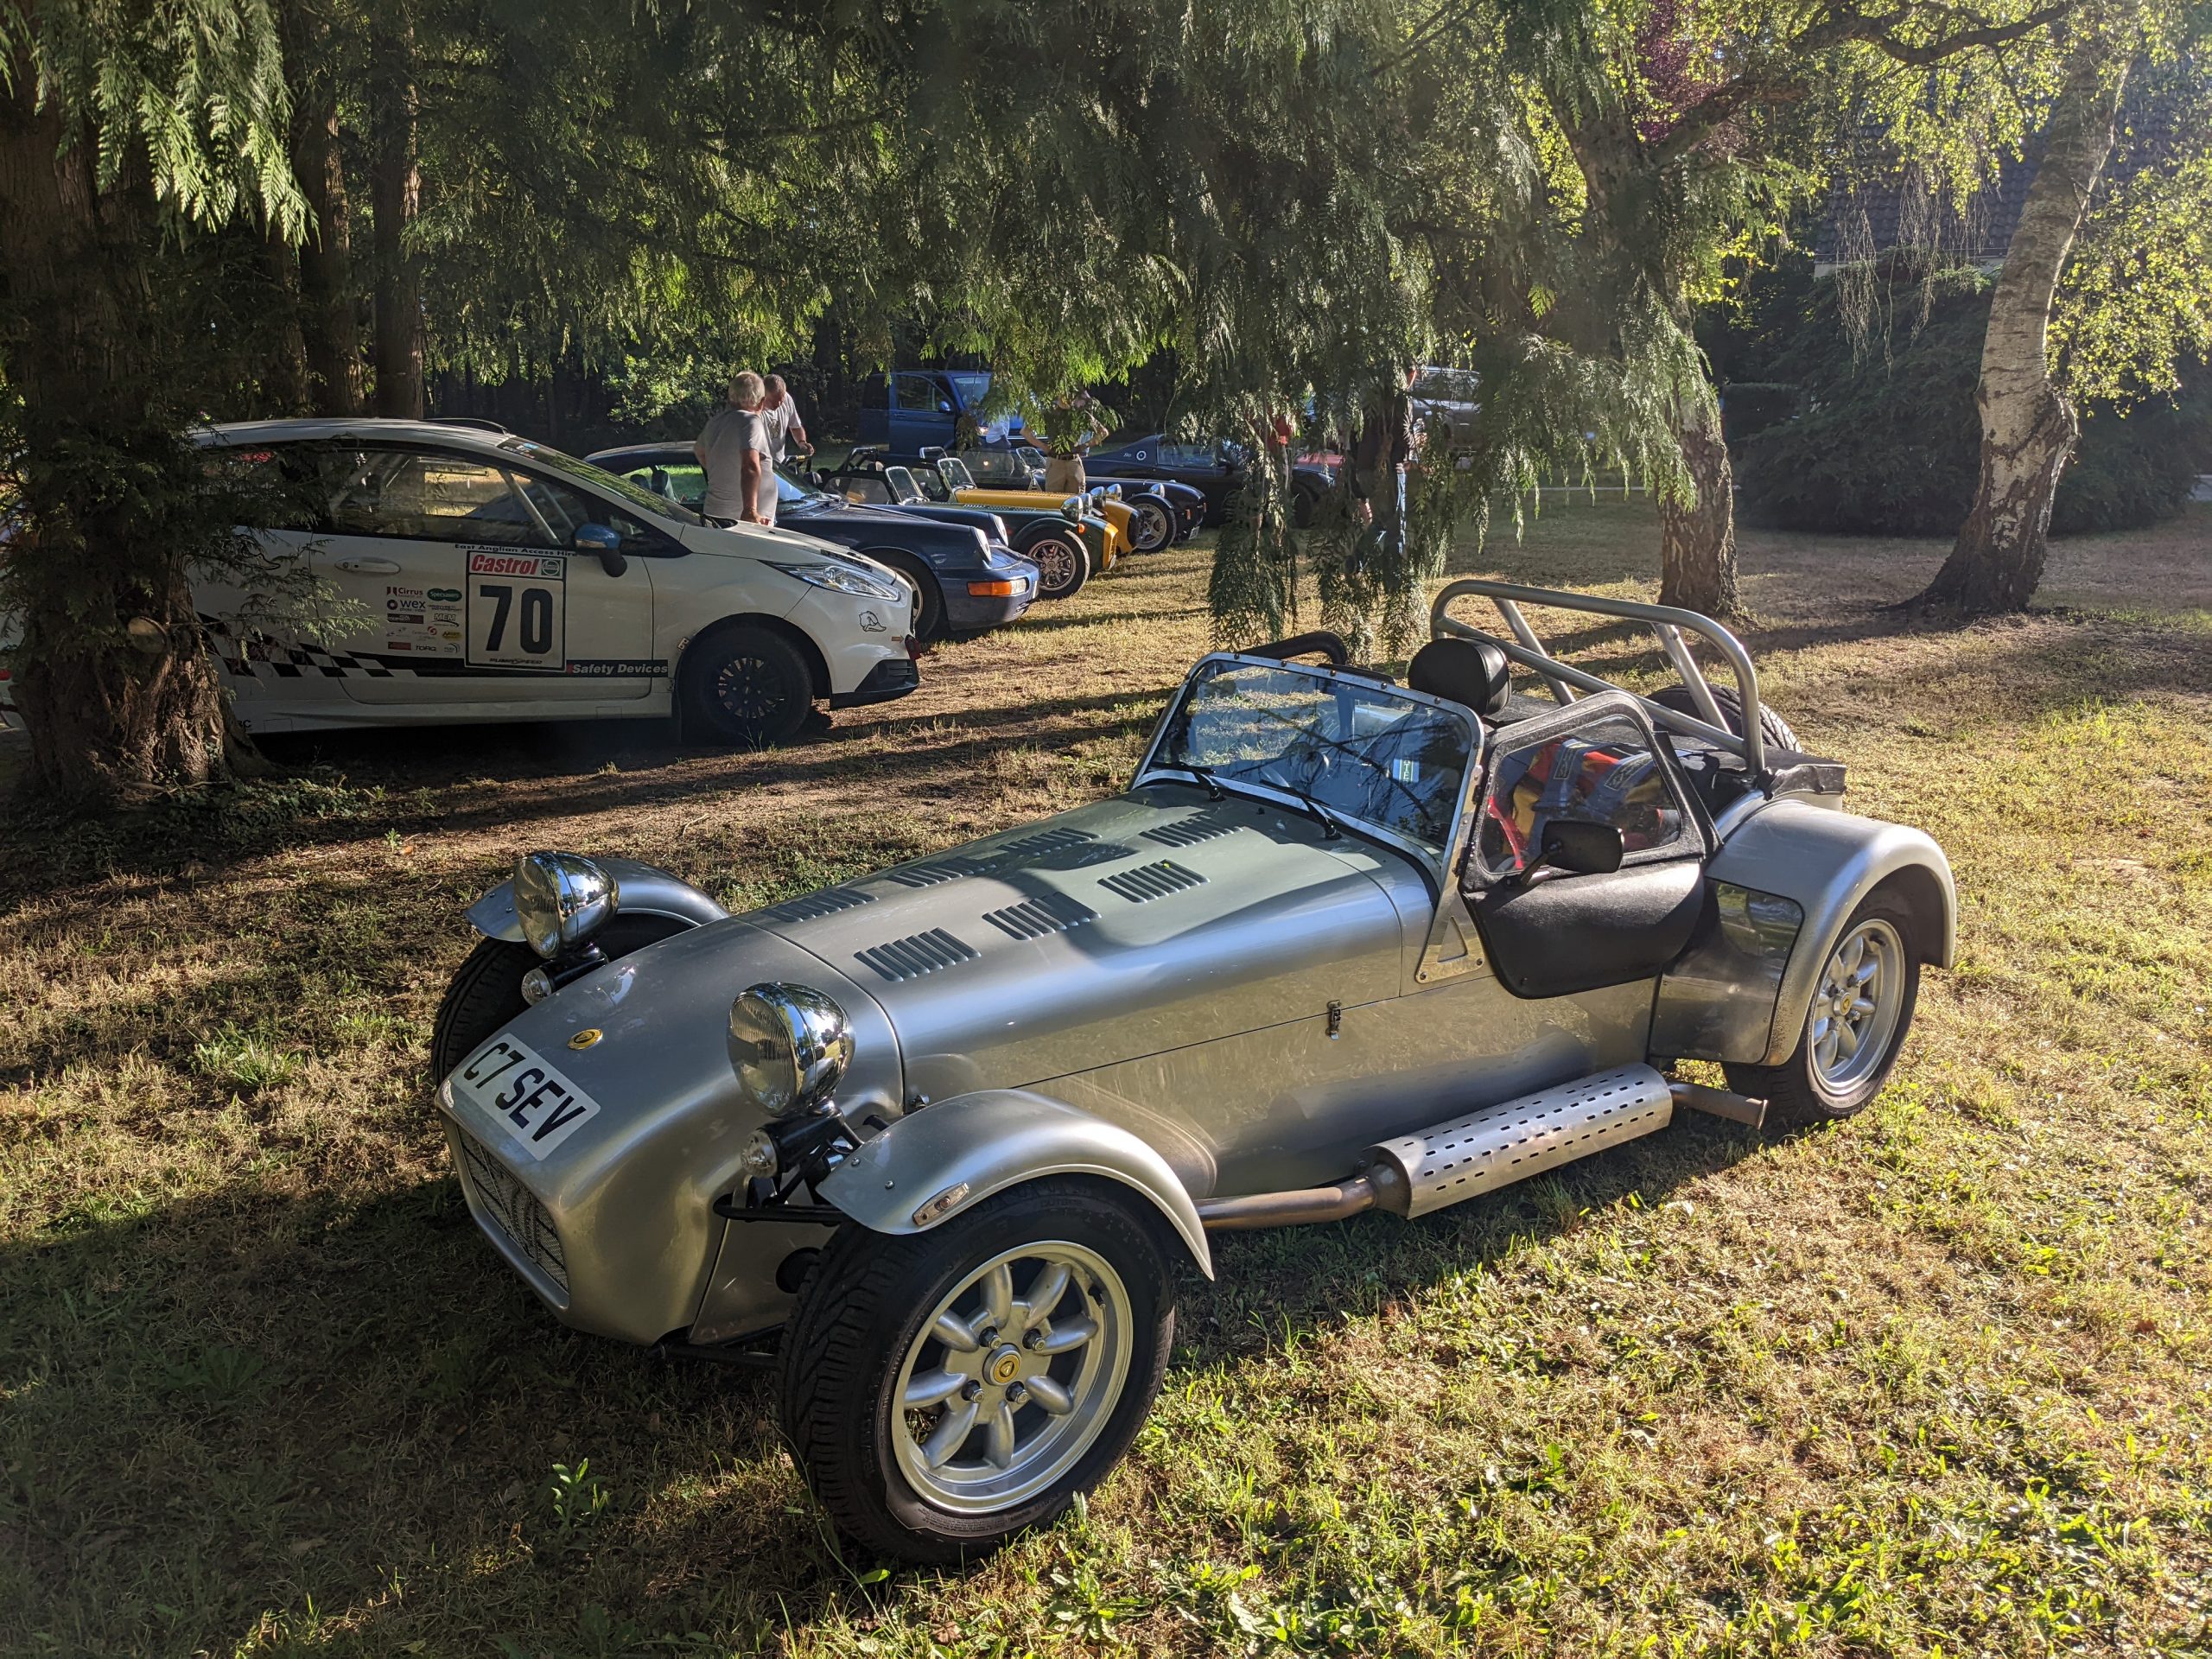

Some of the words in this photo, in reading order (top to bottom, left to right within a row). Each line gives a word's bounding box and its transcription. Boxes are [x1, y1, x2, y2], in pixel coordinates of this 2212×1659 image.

[471, 554, 540, 575] Castrol
[400, 600, 426, 609] wex
[434, 613, 456, 621] MEM
[480, 585, 553, 654] 70
[572, 664, 614, 675] Safety
[617, 664, 669, 674] Devices
[463, 1042, 526, 1090] C7
[494, 1067, 587, 1142] SEV
